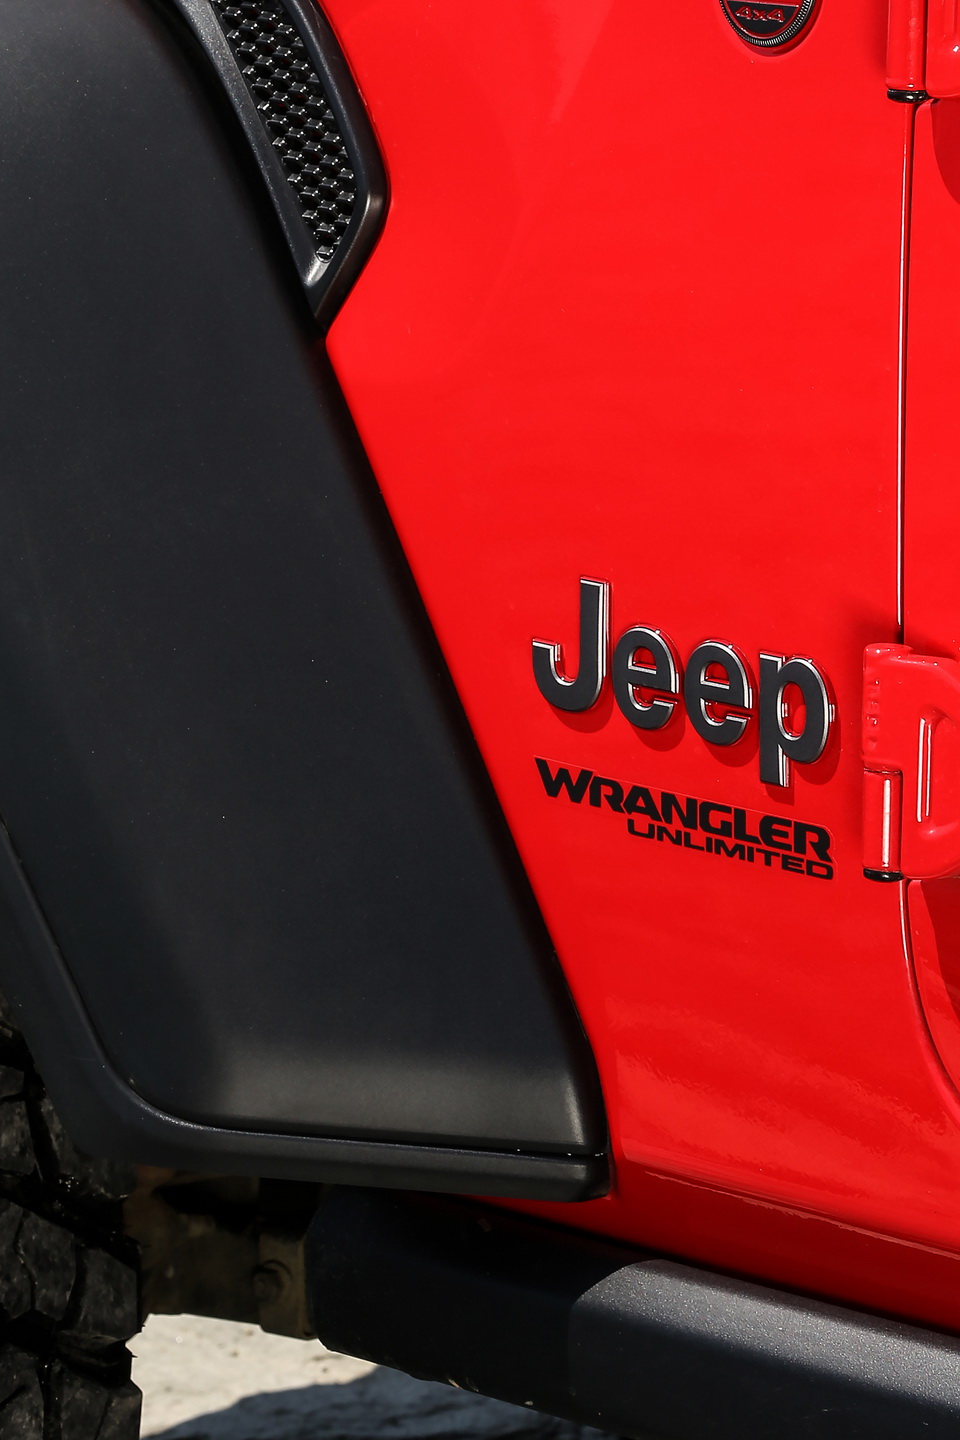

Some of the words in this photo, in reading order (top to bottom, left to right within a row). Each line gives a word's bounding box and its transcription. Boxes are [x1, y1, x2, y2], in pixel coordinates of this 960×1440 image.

[532, 576, 836, 787] Jeep
[534, 757, 834, 863] WRANGLER
[627, 818, 834, 880] UNLIMITED
